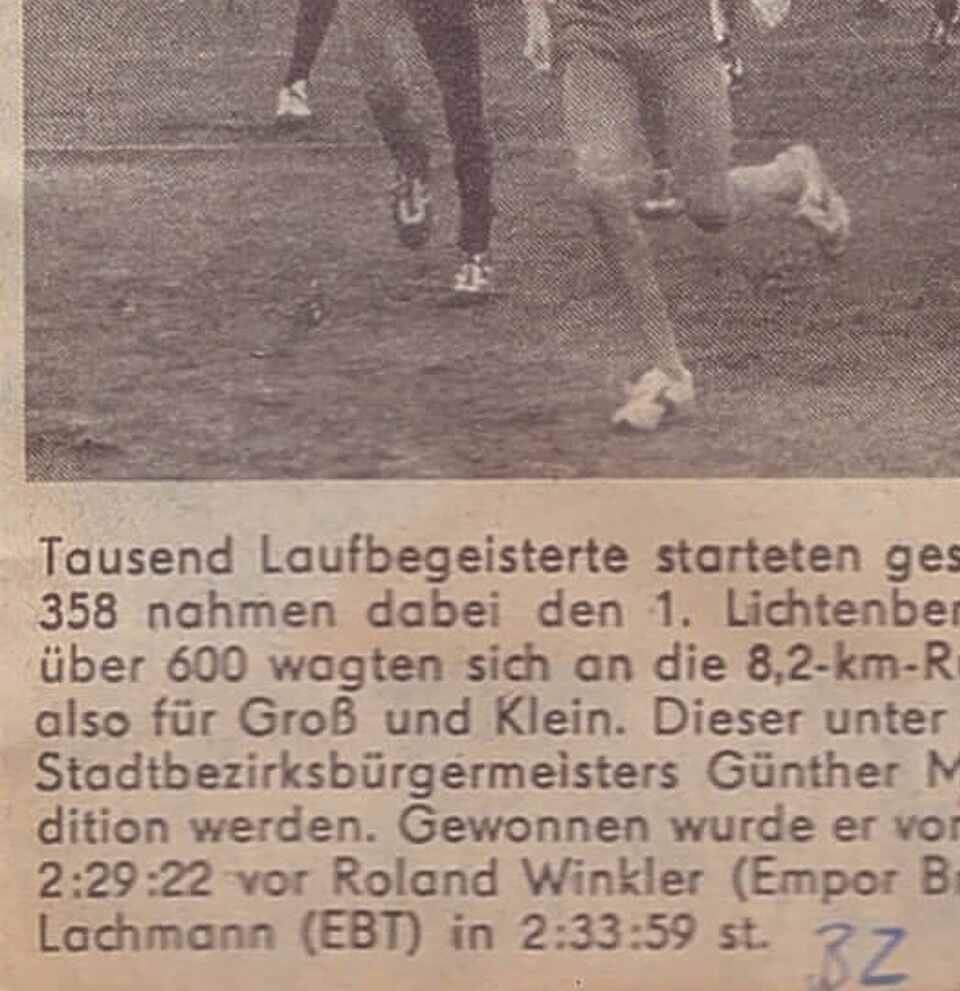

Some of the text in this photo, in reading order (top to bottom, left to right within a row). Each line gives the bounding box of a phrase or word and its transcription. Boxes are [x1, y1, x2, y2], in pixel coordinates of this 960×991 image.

[38, 535, 234, 577] Tausend
[260, 533, 630, 584] Laufbegeisterte
[656, 538, 861, 574] starteten
[37, 591, 118, 631] 358
[147, 589, 336, 630] nahmen
[366, 588, 500, 628] dabei
[537, 588, 623, 628] den
[656, 590, 691, 627] 1.
[40, 642, 146, 684] über
[165, 645, 248, 683] 600
[268, 648, 443, 692] wagten
[466, 642, 551, 682] sich
[574, 654, 635, 682] an
[653, 641, 727, 682] die
[34, 698, 132, 738] also
[151, 696, 217, 737] für
[238, 695, 357, 738] Groß
[385, 697, 471, 736] und
[495, 695, 626, 736] Klein.
[653, 696, 805, 736] Dieser
[825, 702, 948, 735] unter
[35, 750, 680, 799] Stadtbezirksbürgermeisters
[706, 749, 901, 790] Günther
[36, 805, 169, 845] dition
[189, 805, 376, 843] werden.
[397, 803, 650, 844] Gewonnen
[669, 803, 816, 843] wurde
[831, 816, 878, 842] er
[37, 859, 213, 899] 2:29:22
[235, 870, 309, 897] vor
[333, 856, 498, 897] Roland
[521, 856, 704, 896] Winkler
[732, 855, 899, 904] (Empor
[38, 909, 769, 956] Lachmann (EBT) in 2:33:59 st.
[804, 921, 910, 990] BZ
